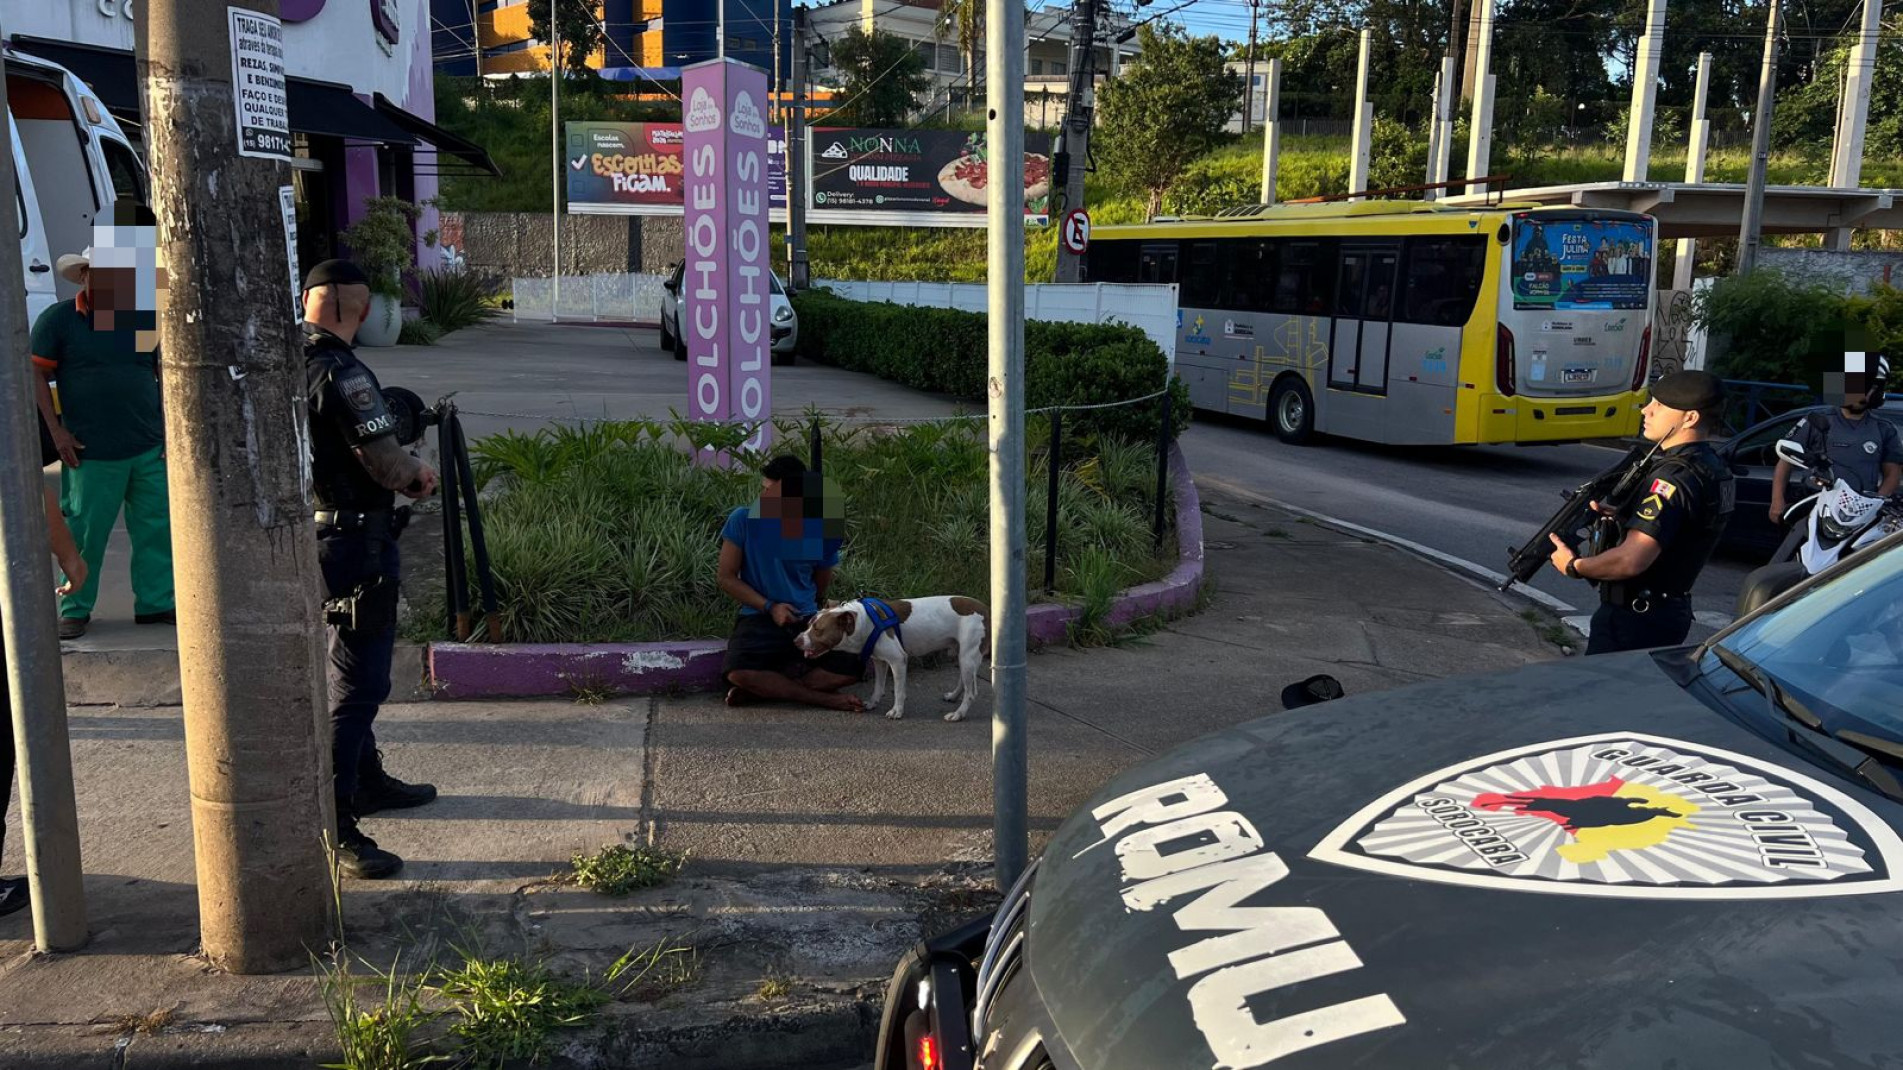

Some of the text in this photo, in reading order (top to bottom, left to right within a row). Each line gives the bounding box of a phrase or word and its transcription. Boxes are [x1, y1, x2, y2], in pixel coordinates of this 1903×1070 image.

[237, 17, 258, 36] TRAGA
[247, 73, 253, 84] E
[242, 89, 266, 102] FAÇO
[268, 93, 273, 102] E
[251, 116, 264, 126] DE
[593, 133, 619, 141] Escolas
[849, 136, 922, 154] NONNA
[848, 164, 909, 182] QUALIDADE
[1562, 233, 1587, 244] FESTA
[1591, 749, 1828, 869] GUARDA CIVIL
[1417, 798, 1529, 867] SOROCABA
[1073, 773, 1406, 1070] ROMU
